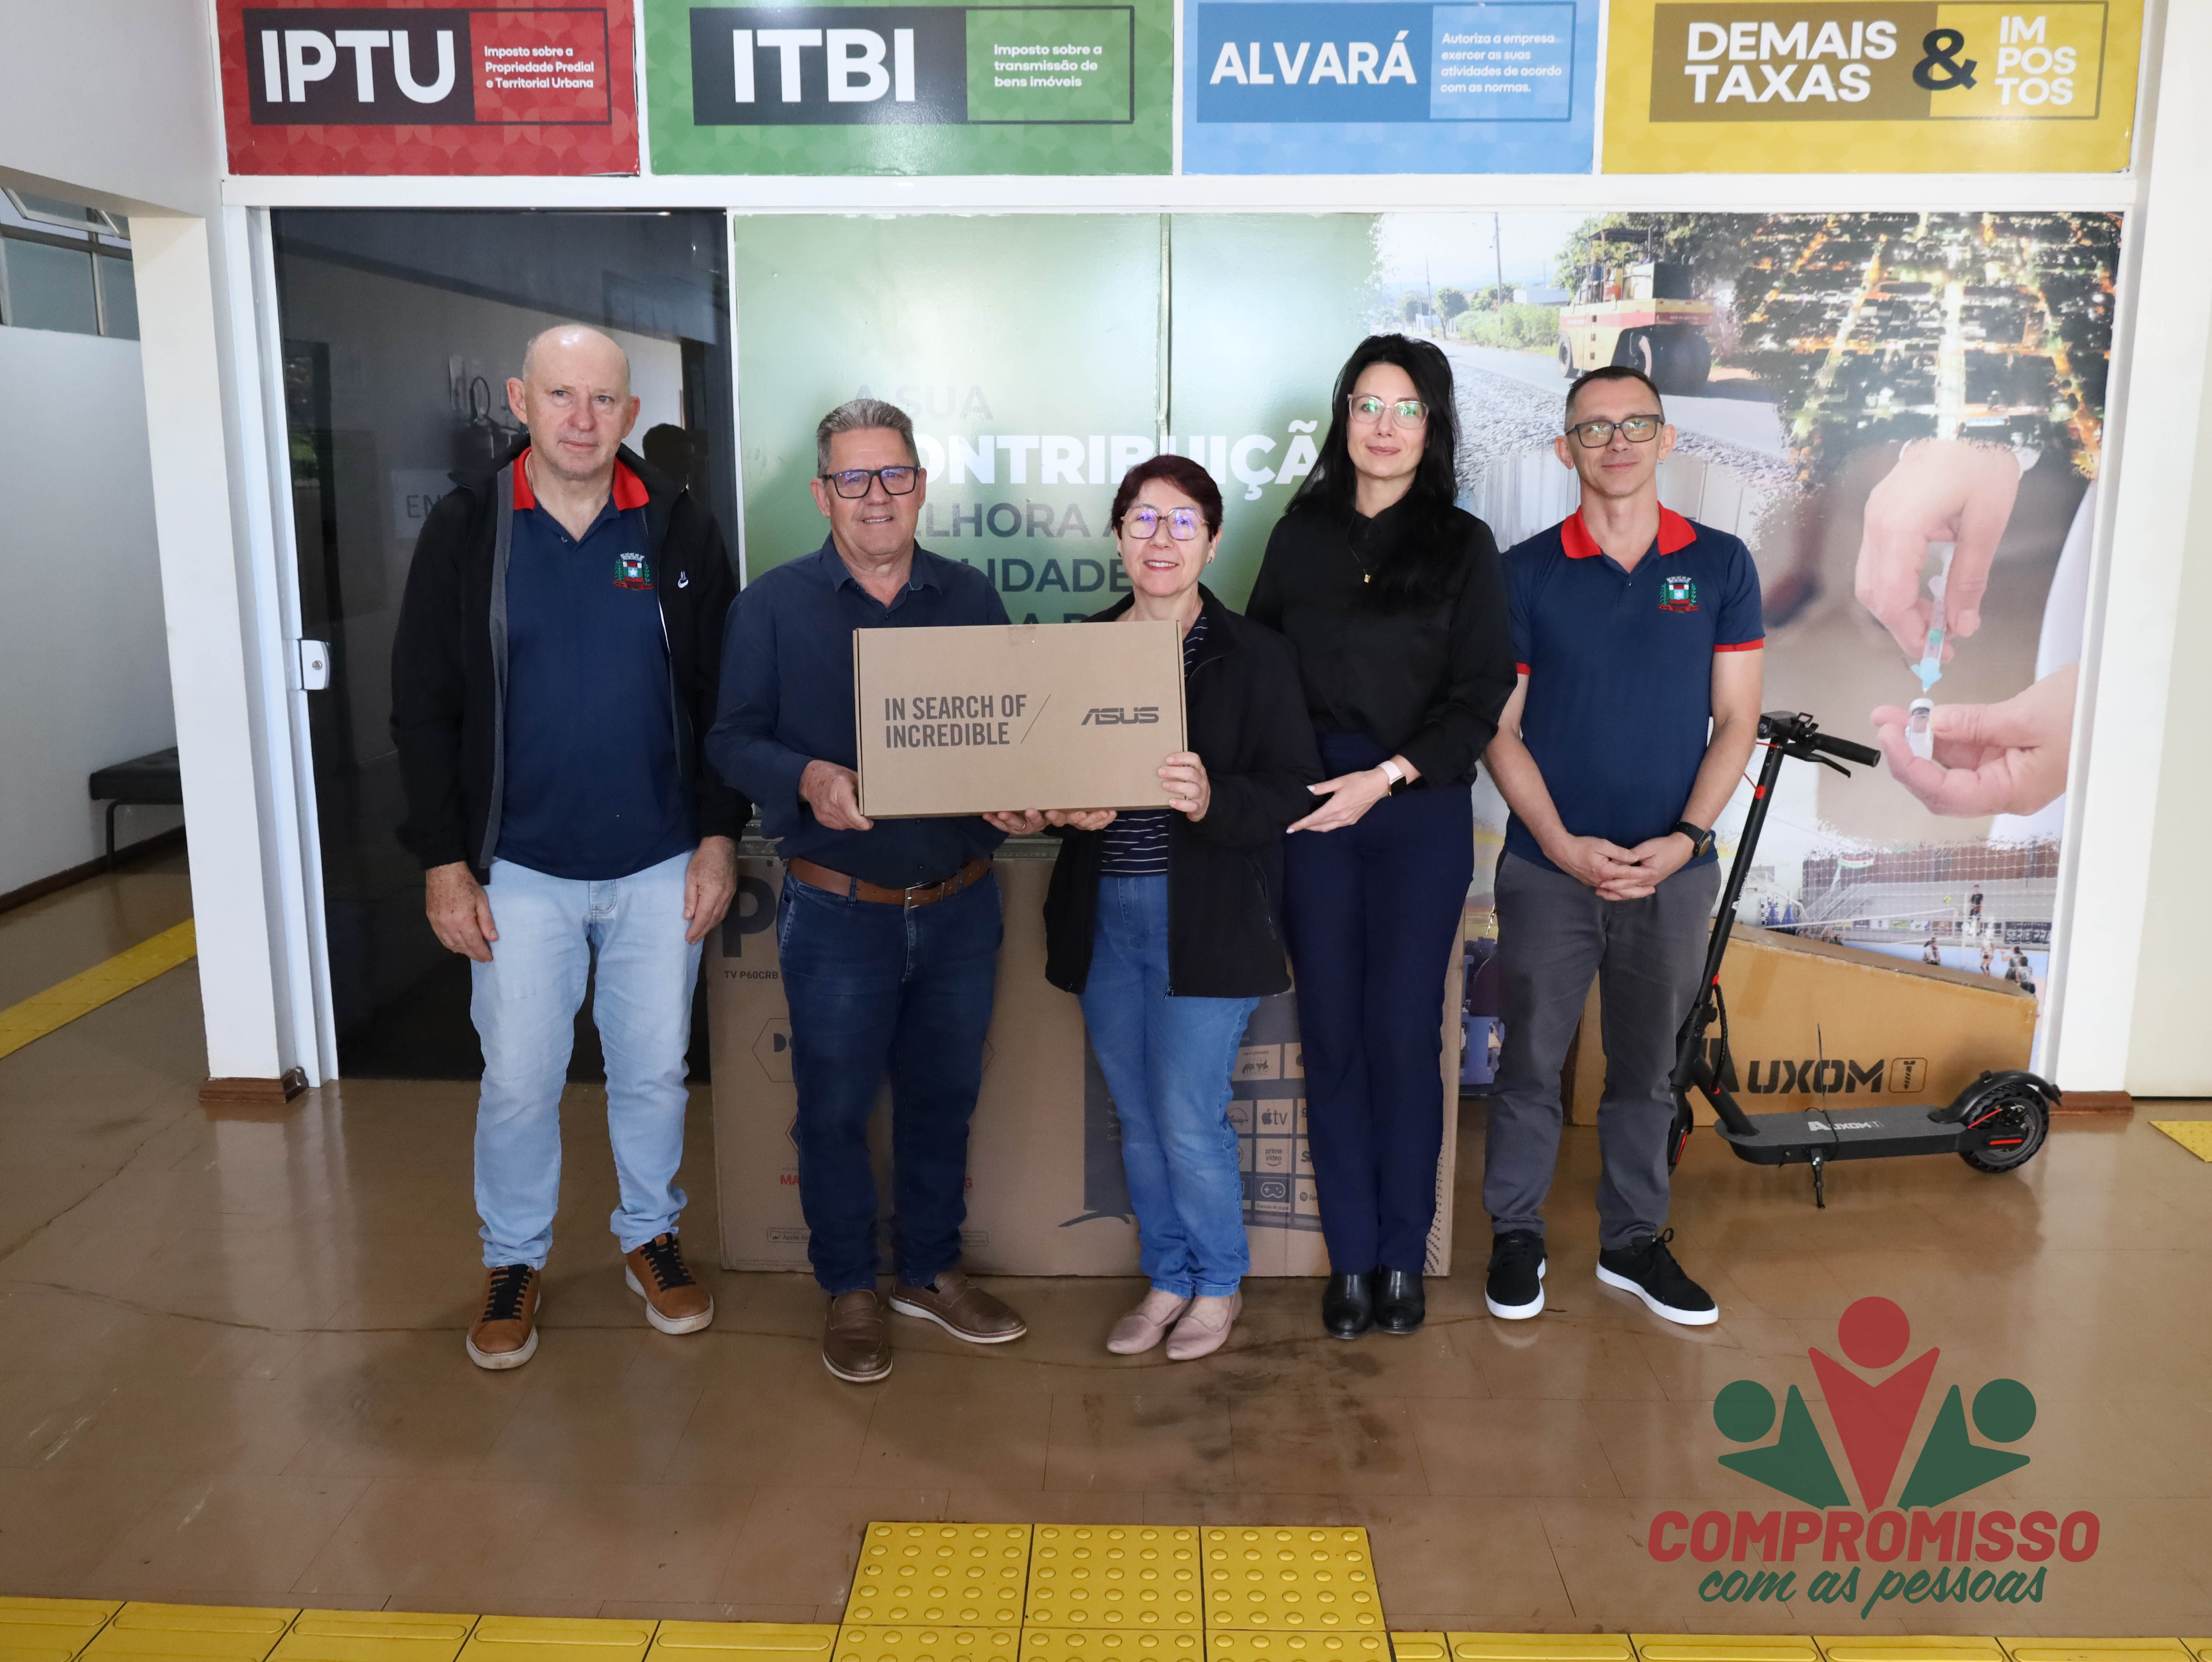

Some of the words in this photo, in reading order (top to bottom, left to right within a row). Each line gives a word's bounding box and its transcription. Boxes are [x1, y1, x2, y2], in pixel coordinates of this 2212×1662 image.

[1442, 32, 1491, 44] Autoriza
[1493, 35, 1501, 44] a
[1504, 34, 1554, 46] empresa
[1999, 16, 2046, 44] IM
[994, 44, 1050, 58] Imposto
[1052, 44, 1090, 55] sobre
[1093, 46, 1102, 55] a
[1687, 21, 1897, 61] DEMAIS
[484, 46, 530, 59] Imposto
[532, 46, 563, 56] sobre
[565, 48, 573, 56] a
[1210, 30, 1417, 84] ALVARÁ
[1442, 51, 1486, 60] exercer
[1488, 51, 1501, 60] as
[1504, 51, 1531, 60] suas
[1912, 28, 1977, 91] &
[1997, 46, 2077, 76] POS
[261, 30, 455, 103] IPTU
[485, 62, 553, 75] Propriedade
[555, 61, 594, 72] Predial
[733, 28, 915, 103] ITBI
[994, 60, 1078, 71] transmissão
[1080, 60, 1098, 71] de
[1441, 66, 1501, 77] atividades
[1504, 66, 1518, 76] de
[1520, 66, 1562, 76] acordo
[495, 78, 549, 88] Territorial
[551, 78, 593, 88] Urbana
[995, 76, 1027, 87] bens
[1030, 76, 1082, 87] imóveis
[1440, 84, 1466, 93] com
[1468, 84, 1482, 93] as
[1484, 83, 1531, 93] normas.
[1684, 64, 1871, 103] TAXAS
[1995, 77, 2074, 105] TOS
[885, 698, 905, 721] IN
[912, 695, 993, 720] SEARCH
[1001, 694, 1027, 718] OF
[1081, 706, 1159, 726] ASUS
[886, 722, 1010, 748] INCREDIBLE
[1273, 1110, 1288, 1125] tv
